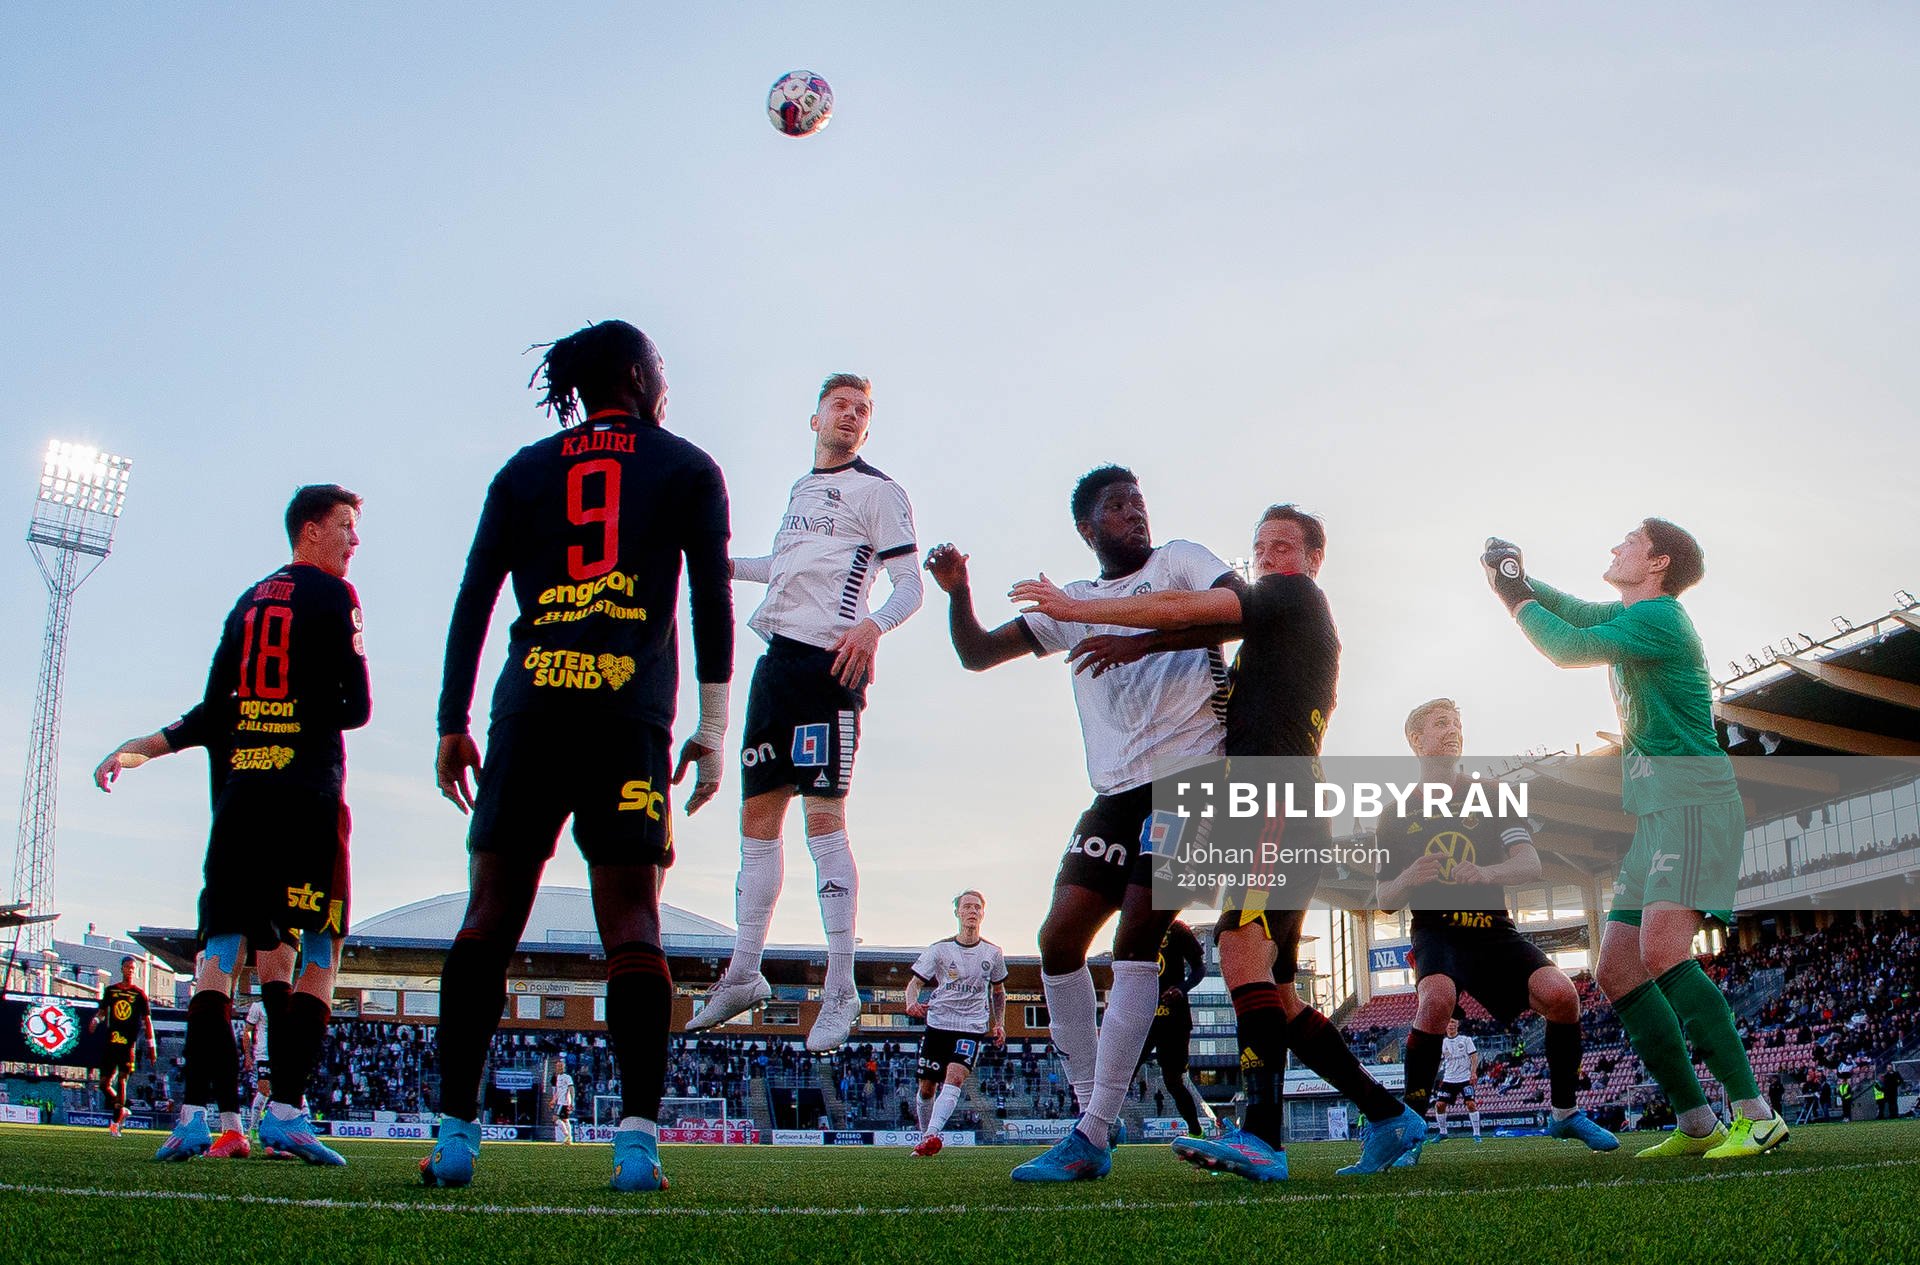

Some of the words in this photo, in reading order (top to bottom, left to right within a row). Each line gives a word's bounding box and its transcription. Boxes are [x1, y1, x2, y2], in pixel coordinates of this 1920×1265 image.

[560, 431, 637, 456] KADIRI
[567, 458, 622, 580] 9
[238, 605, 294, 699] 18
[523, 646, 596, 671] ÖSTER
[534, 668, 603, 689] SUND
[240, 700, 294, 720] ngcon
[1374, 950, 1400, 968] NA
[339, 1123, 372, 1136] ÖBAB
[388, 1124, 422, 1137] ÖBAB
